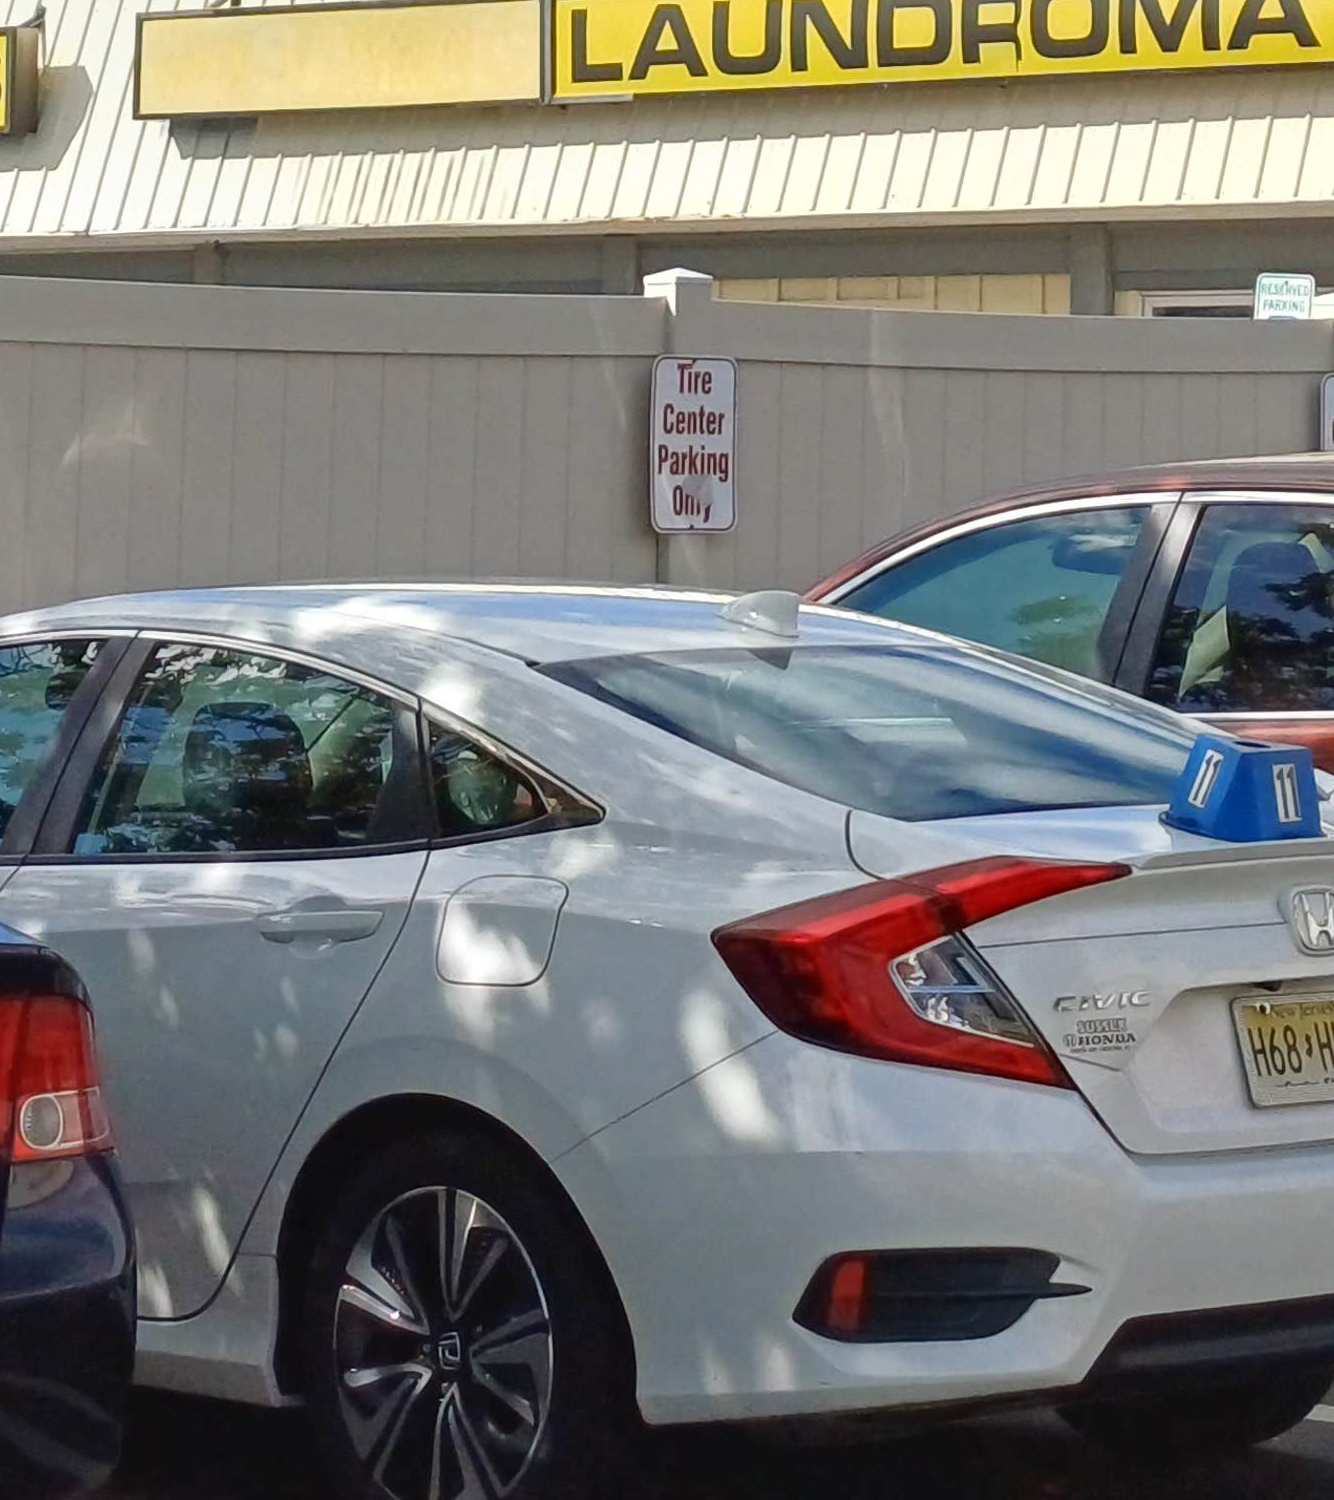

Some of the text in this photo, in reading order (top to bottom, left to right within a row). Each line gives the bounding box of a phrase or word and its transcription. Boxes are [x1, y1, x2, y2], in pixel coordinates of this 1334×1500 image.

[1260, 282, 1310, 297] RESERVED
[1263, 300, 1306, 313] PARKING
[677, 362, 712, 394] Tire
[663, 403, 725, 435] Center
[657, 444, 729, 482] Parking
[1192, 753, 1222, 806] 11
[1276, 766, 1300, 820] 11
[1052, 990, 1152, 1012] CIVIC
[1078, 1033, 1137, 1046] HONDA
